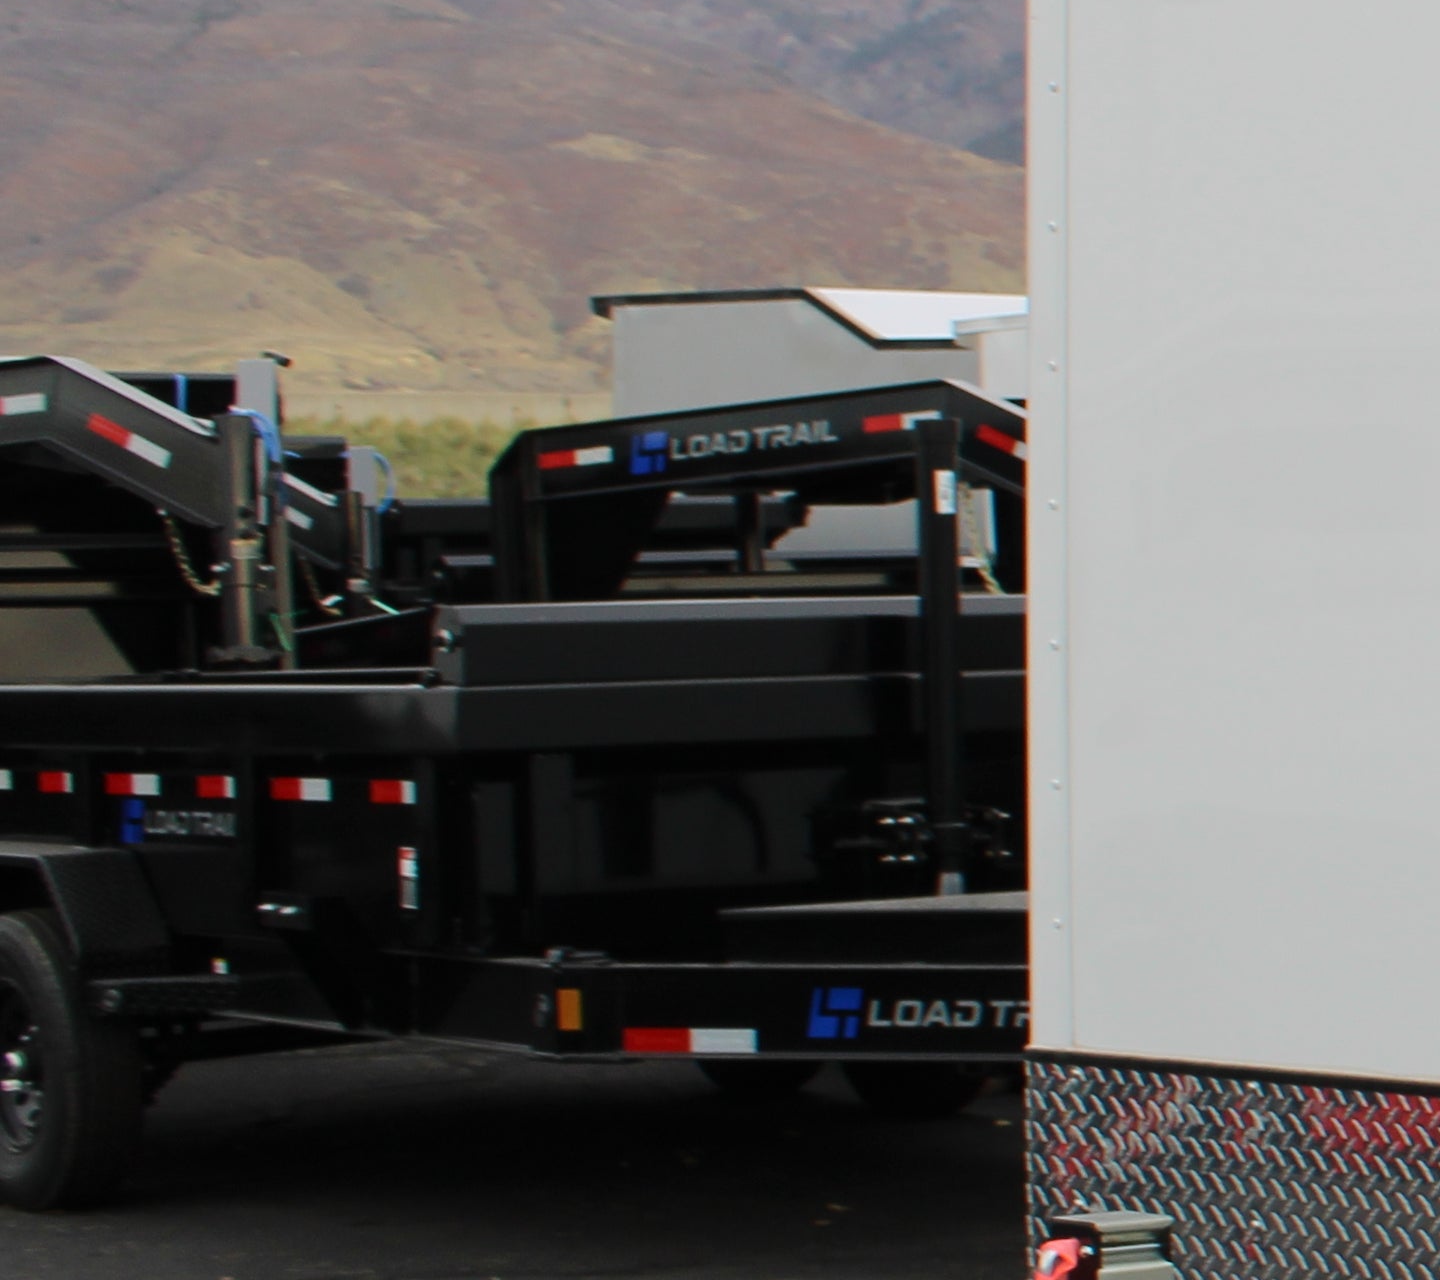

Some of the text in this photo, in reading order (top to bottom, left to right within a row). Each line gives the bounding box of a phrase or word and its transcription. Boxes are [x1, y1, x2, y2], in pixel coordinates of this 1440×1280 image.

[669, 420, 840, 461] LOAD TRAIL
[867, 999, 983, 1028] LOAD
